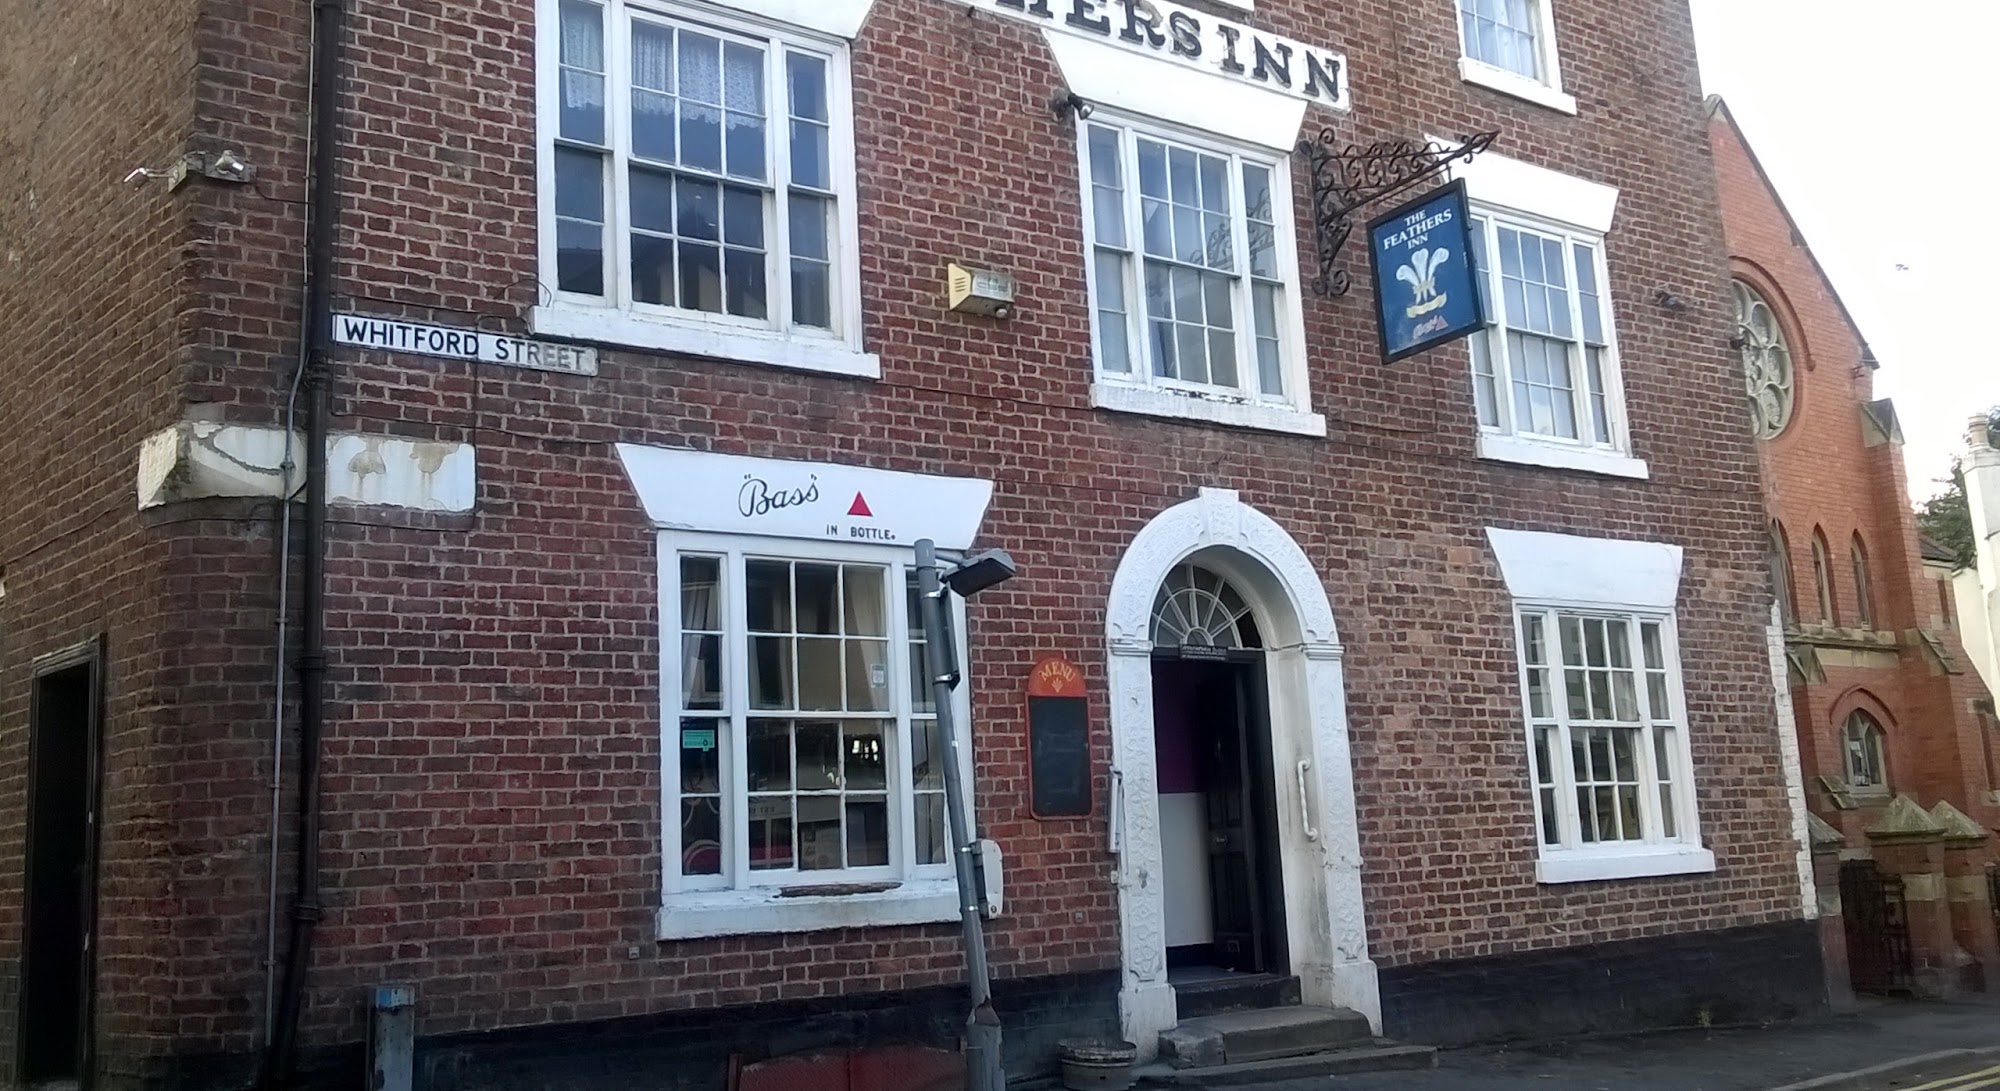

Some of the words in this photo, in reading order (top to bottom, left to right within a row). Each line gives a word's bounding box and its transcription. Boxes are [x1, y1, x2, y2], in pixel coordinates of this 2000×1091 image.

[995, 0, 1201, 59] ERS
[1216, 23, 1341, 103] INN
[1404, 209, 1427, 227] THE
[1383, 208, 1453, 251] FEATHERS
[1407, 232, 1429, 250] INN
[344, 318, 479, 356] WHITFORD
[495, 338, 586, 371] STREET
[826, 524, 838, 536] IN
[850, 526, 896, 541] BOTTLE.
[1038, 661, 1077, 682] MENU
